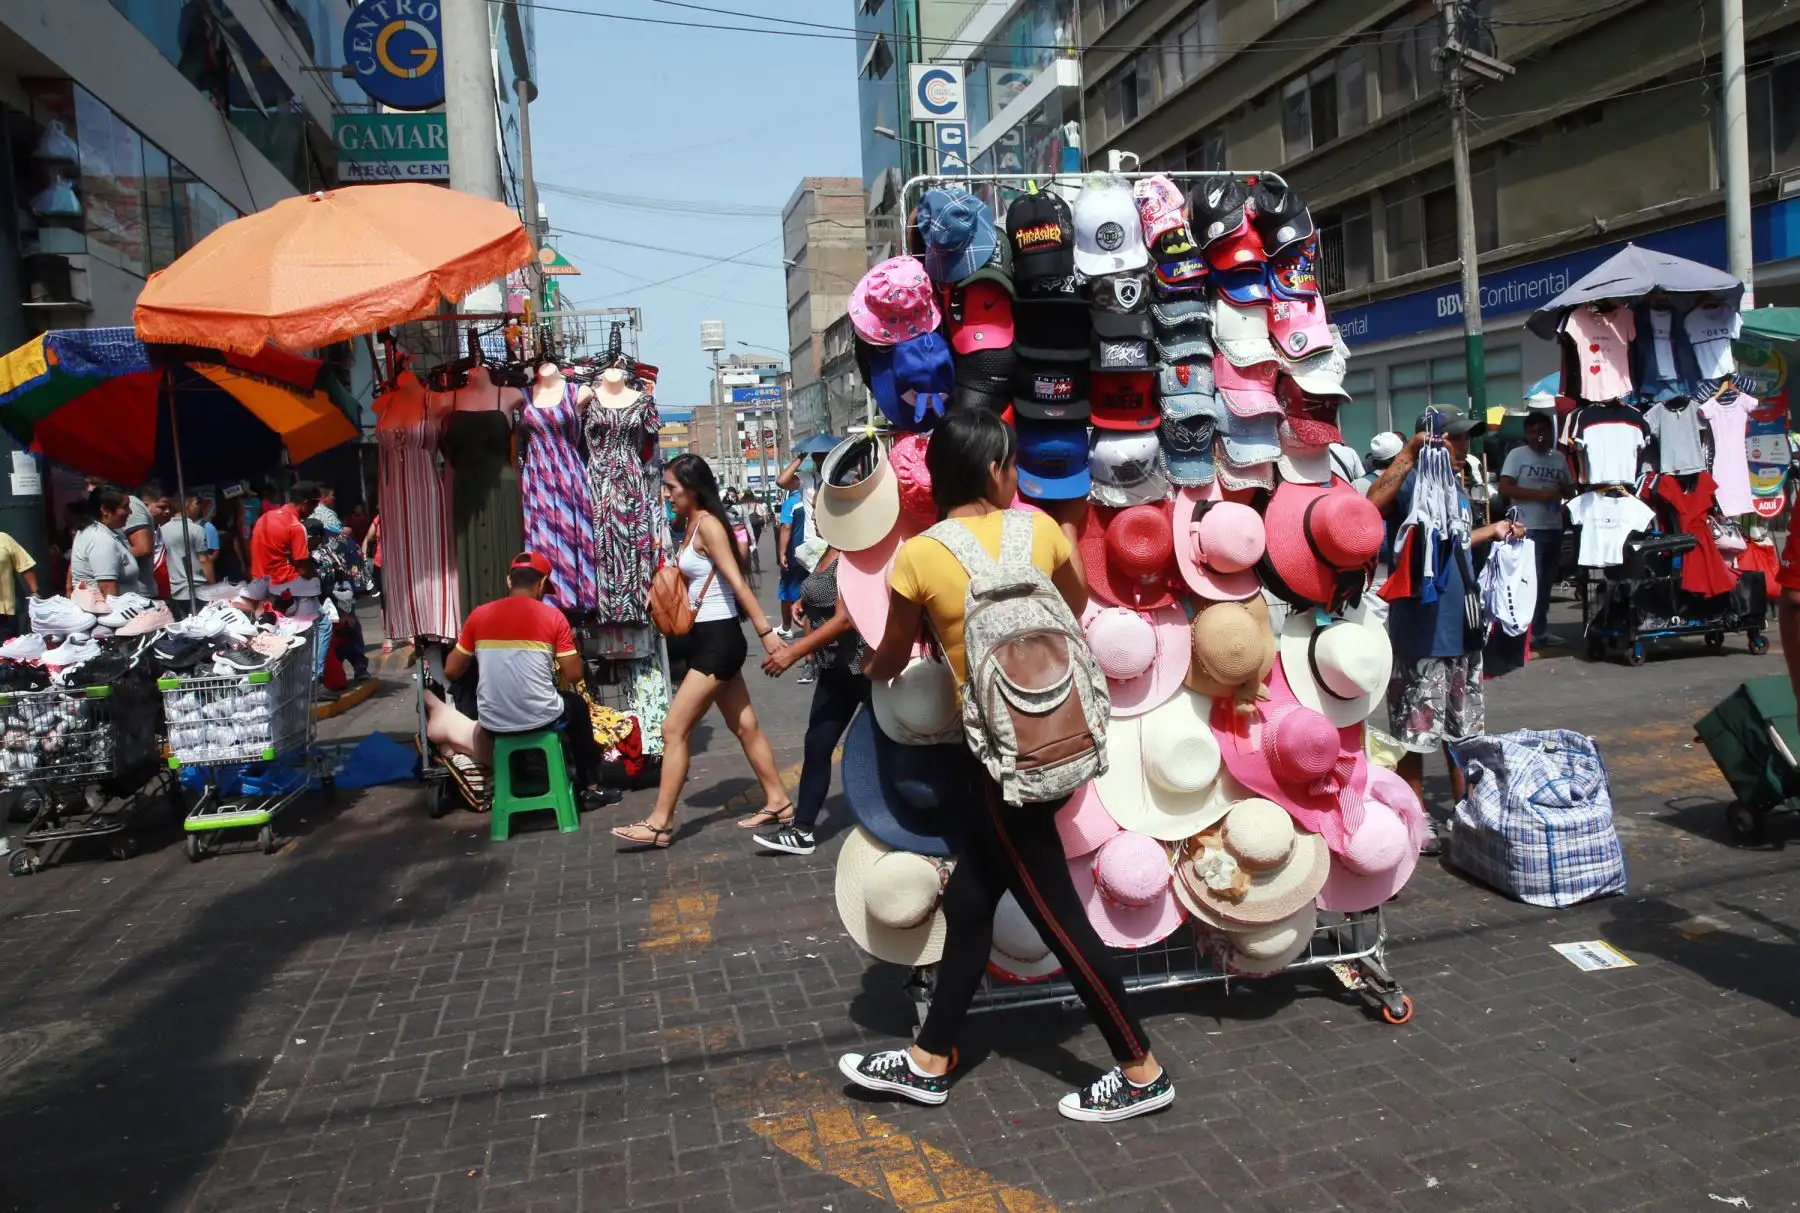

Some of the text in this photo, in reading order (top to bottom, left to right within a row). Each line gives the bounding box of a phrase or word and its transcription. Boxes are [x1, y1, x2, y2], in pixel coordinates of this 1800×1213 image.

[353, 0, 438, 75] CENTRO
[1016, 224, 1062, 248] THRASHER
[1437, 268, 1569, 318] BBV Continental
